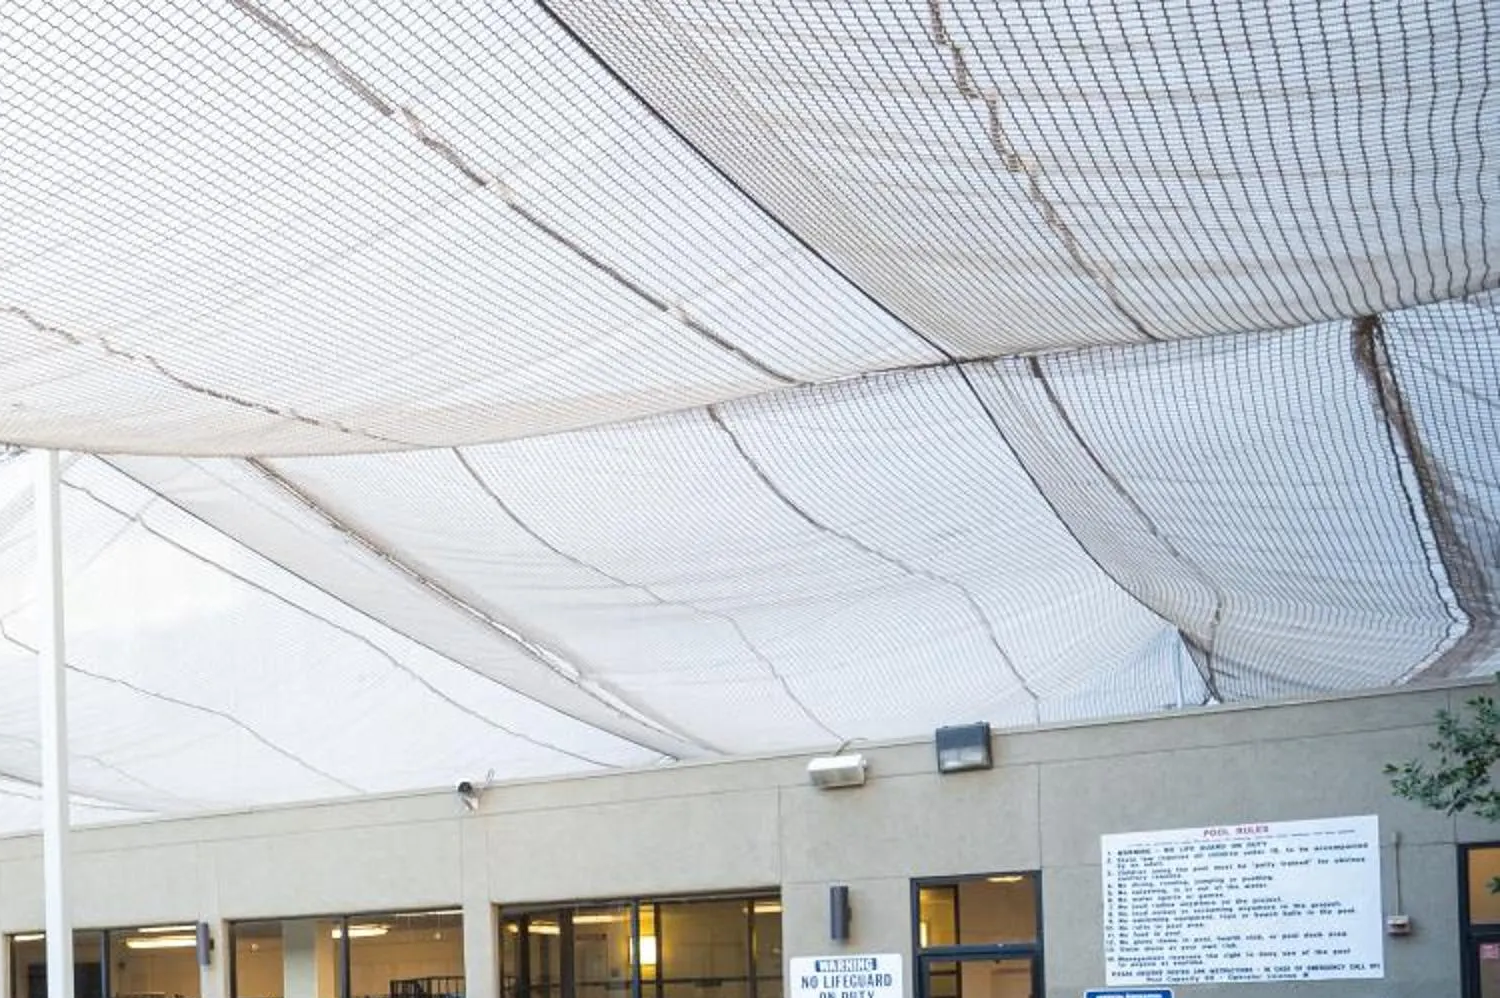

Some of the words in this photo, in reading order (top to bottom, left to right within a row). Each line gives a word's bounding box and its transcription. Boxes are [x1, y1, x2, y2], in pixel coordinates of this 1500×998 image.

[1204, 828, 1229, 838] POOL
[1236, 825, 1269, 836] RULES
[819, 958, 873, 972] WARNING
[801, 975, 819, 989] NO
[823, 973, 893, 989] LIFEGUARD
